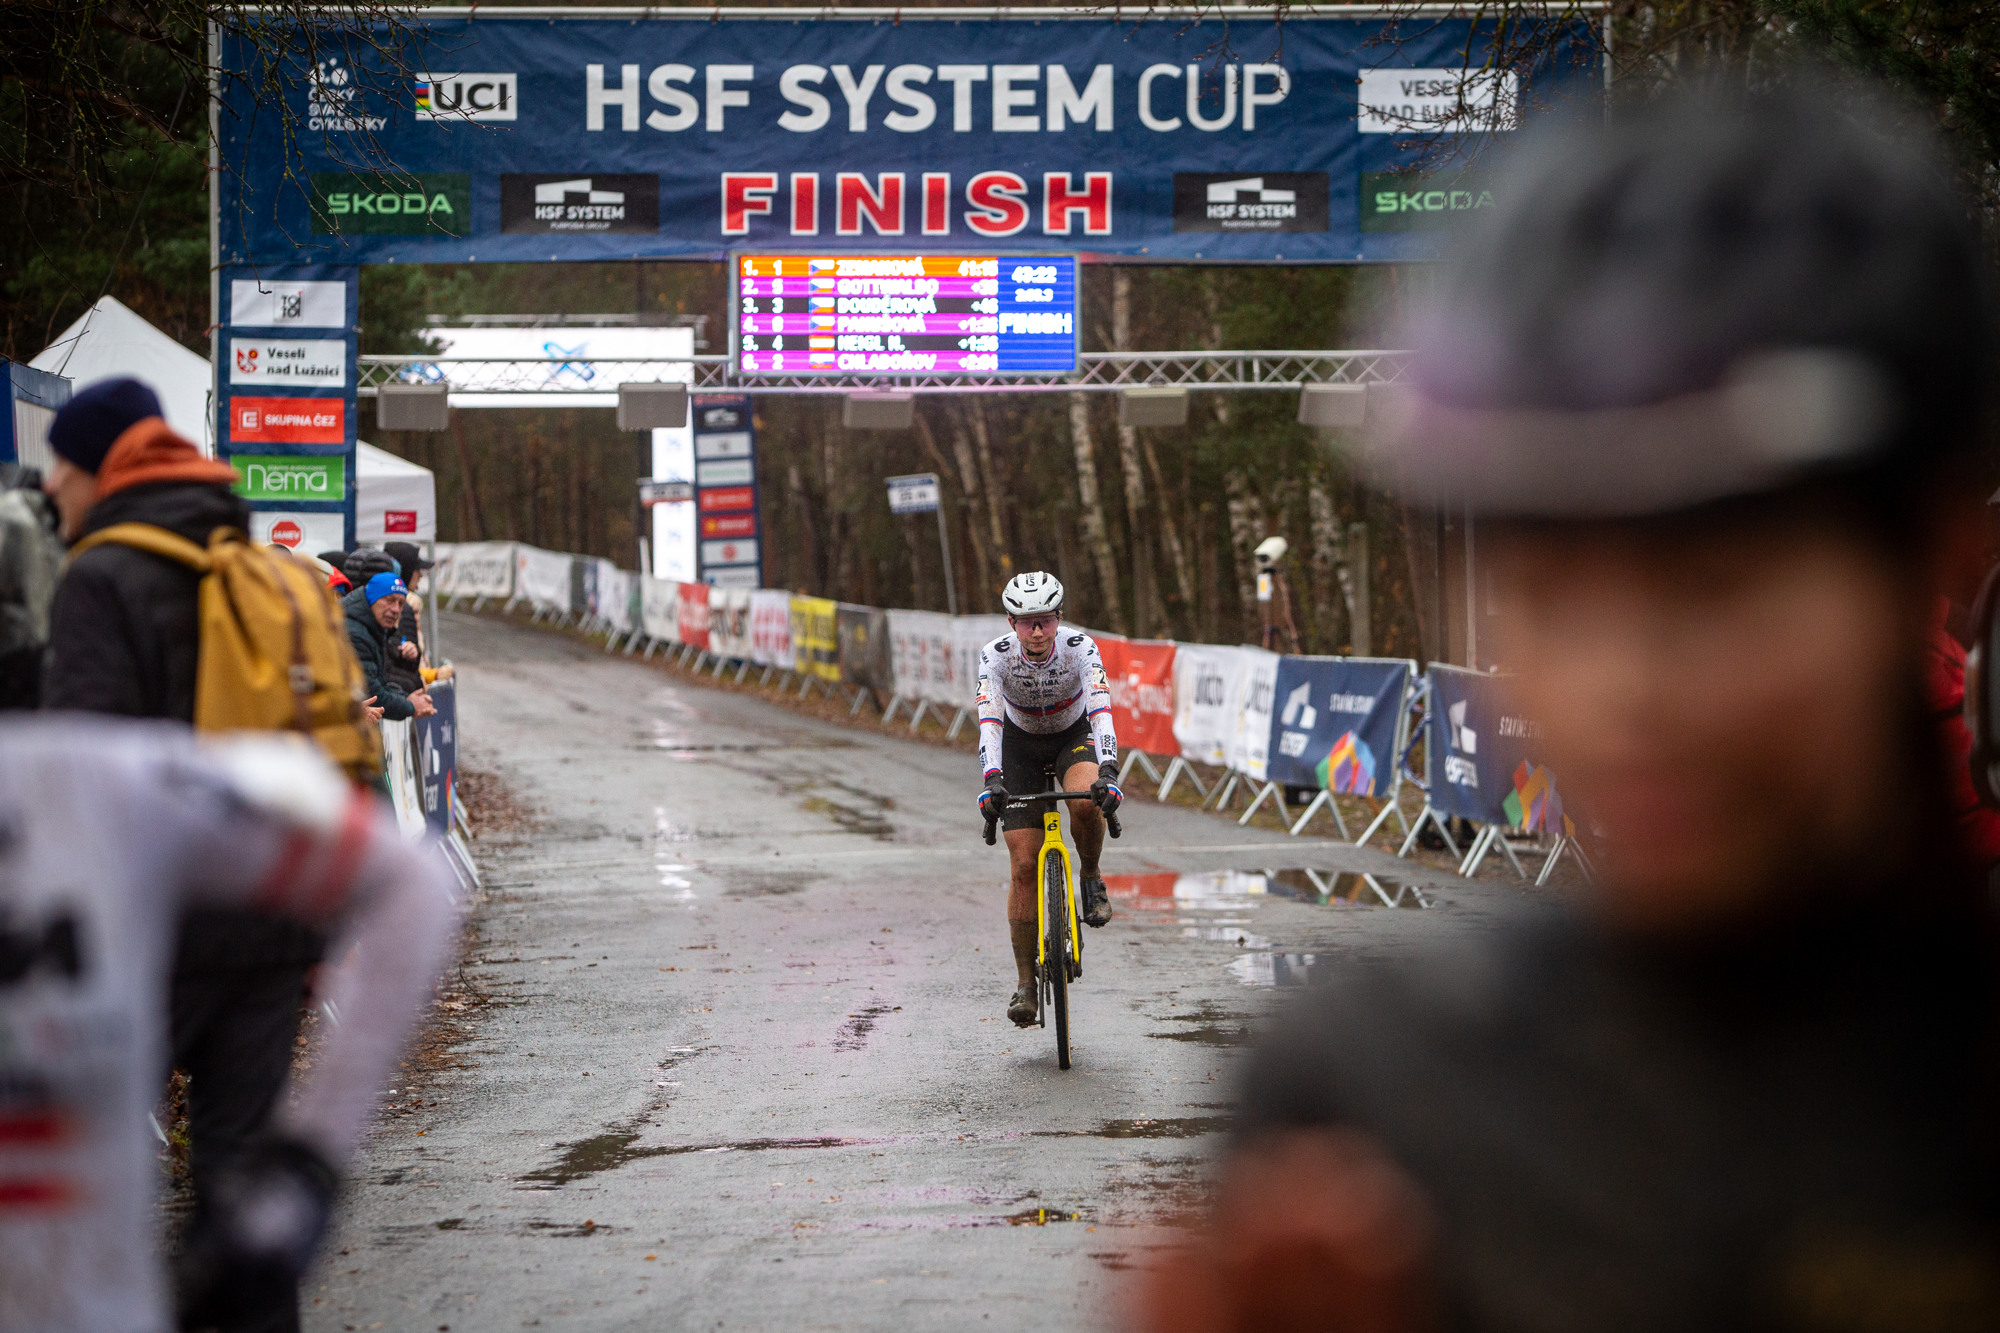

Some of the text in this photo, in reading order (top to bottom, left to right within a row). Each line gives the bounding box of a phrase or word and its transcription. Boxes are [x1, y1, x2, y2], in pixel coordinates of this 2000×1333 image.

[434, 83, 507, 111] UCI
[585, 63, 1291, 132] HSF SYSTEM CUP
[721, 171, 1112, 236] FINISH
[1207, 204, 1296, 218] HSF SYSTEM
[535, 206, 624, 220] HSF SYSTEM
[772, 259, 784, 276] 1
[772, 297, 784, 313] 3
[772, 335, 784, 351] 4
[267, 347, 305, 359] Veselí
[267, 363, 339, 377] nad Lužnicí
[265, 412, 336, 427] SKUPINA ČEZ
